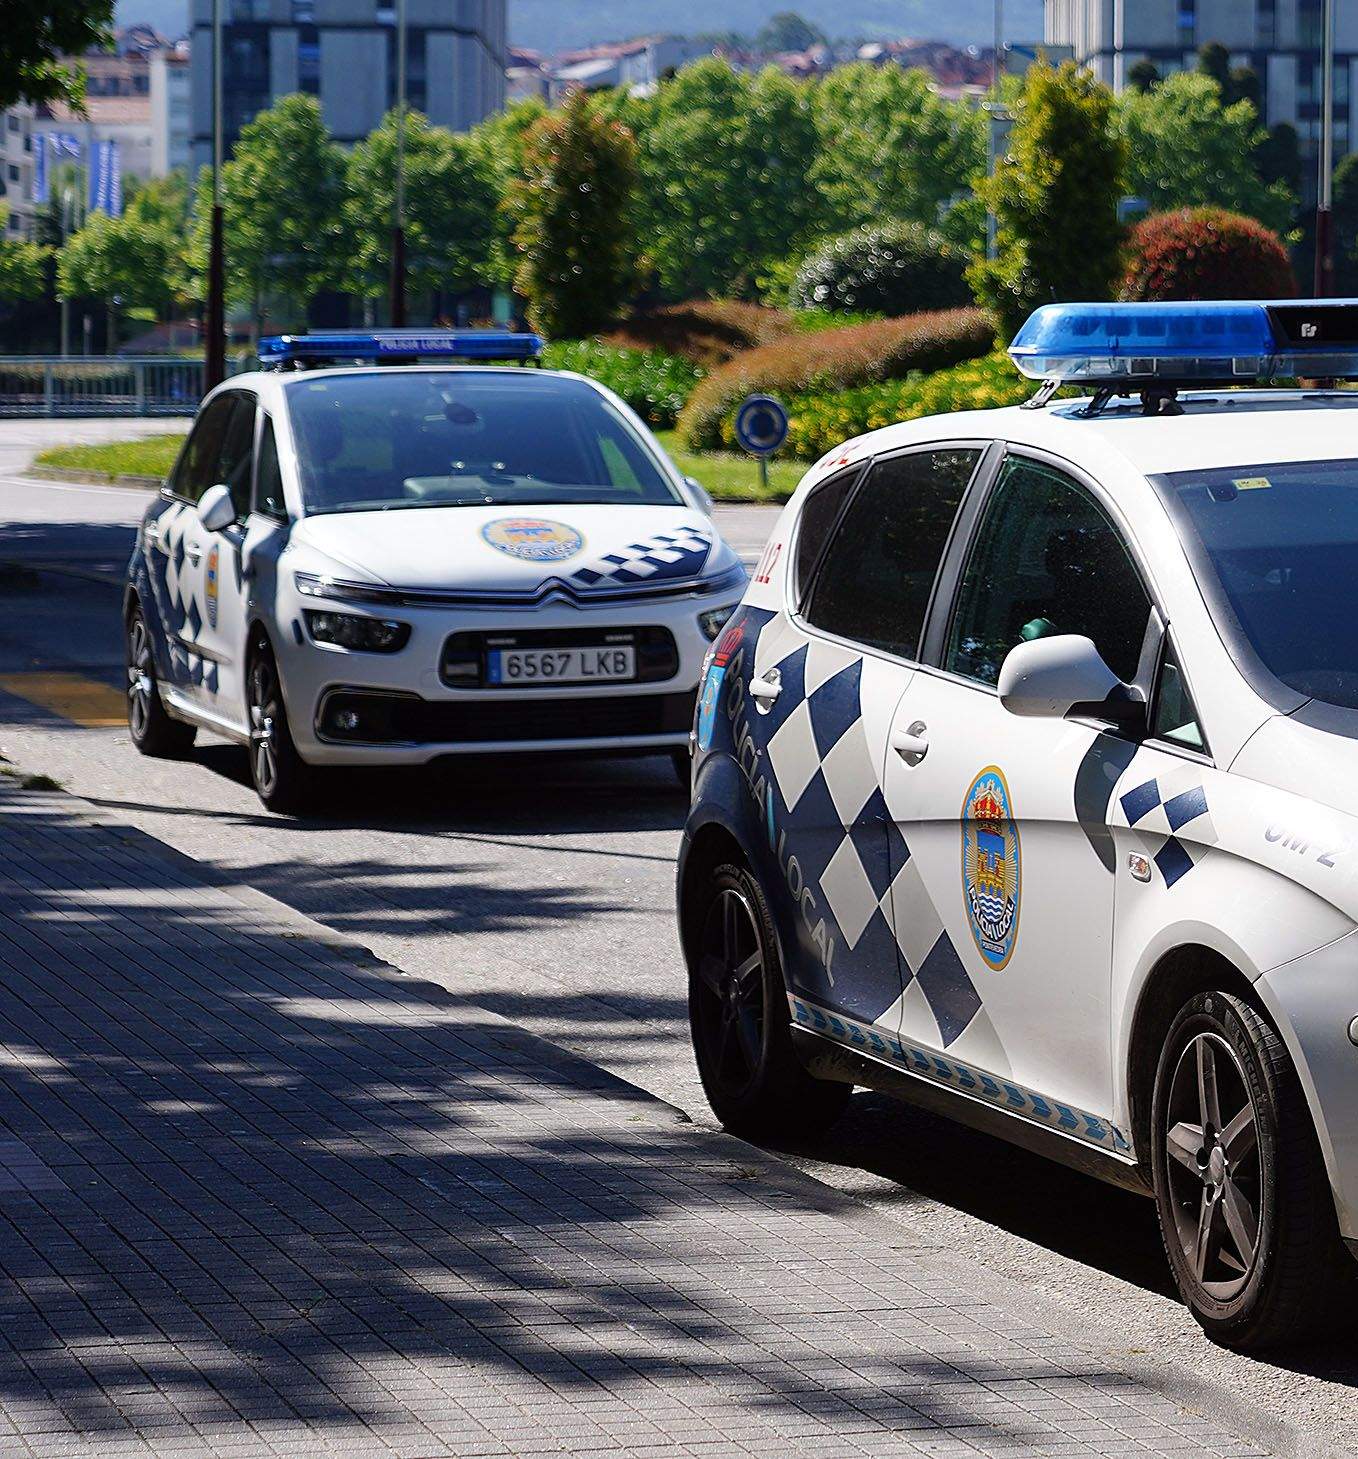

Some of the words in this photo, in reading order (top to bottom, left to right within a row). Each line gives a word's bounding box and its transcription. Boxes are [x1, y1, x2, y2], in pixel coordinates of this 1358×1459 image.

[507, 653, 571, 678] 6567
[580, 651, 627, 675] LKB
[778, 828, 836, 988] LOCAL
